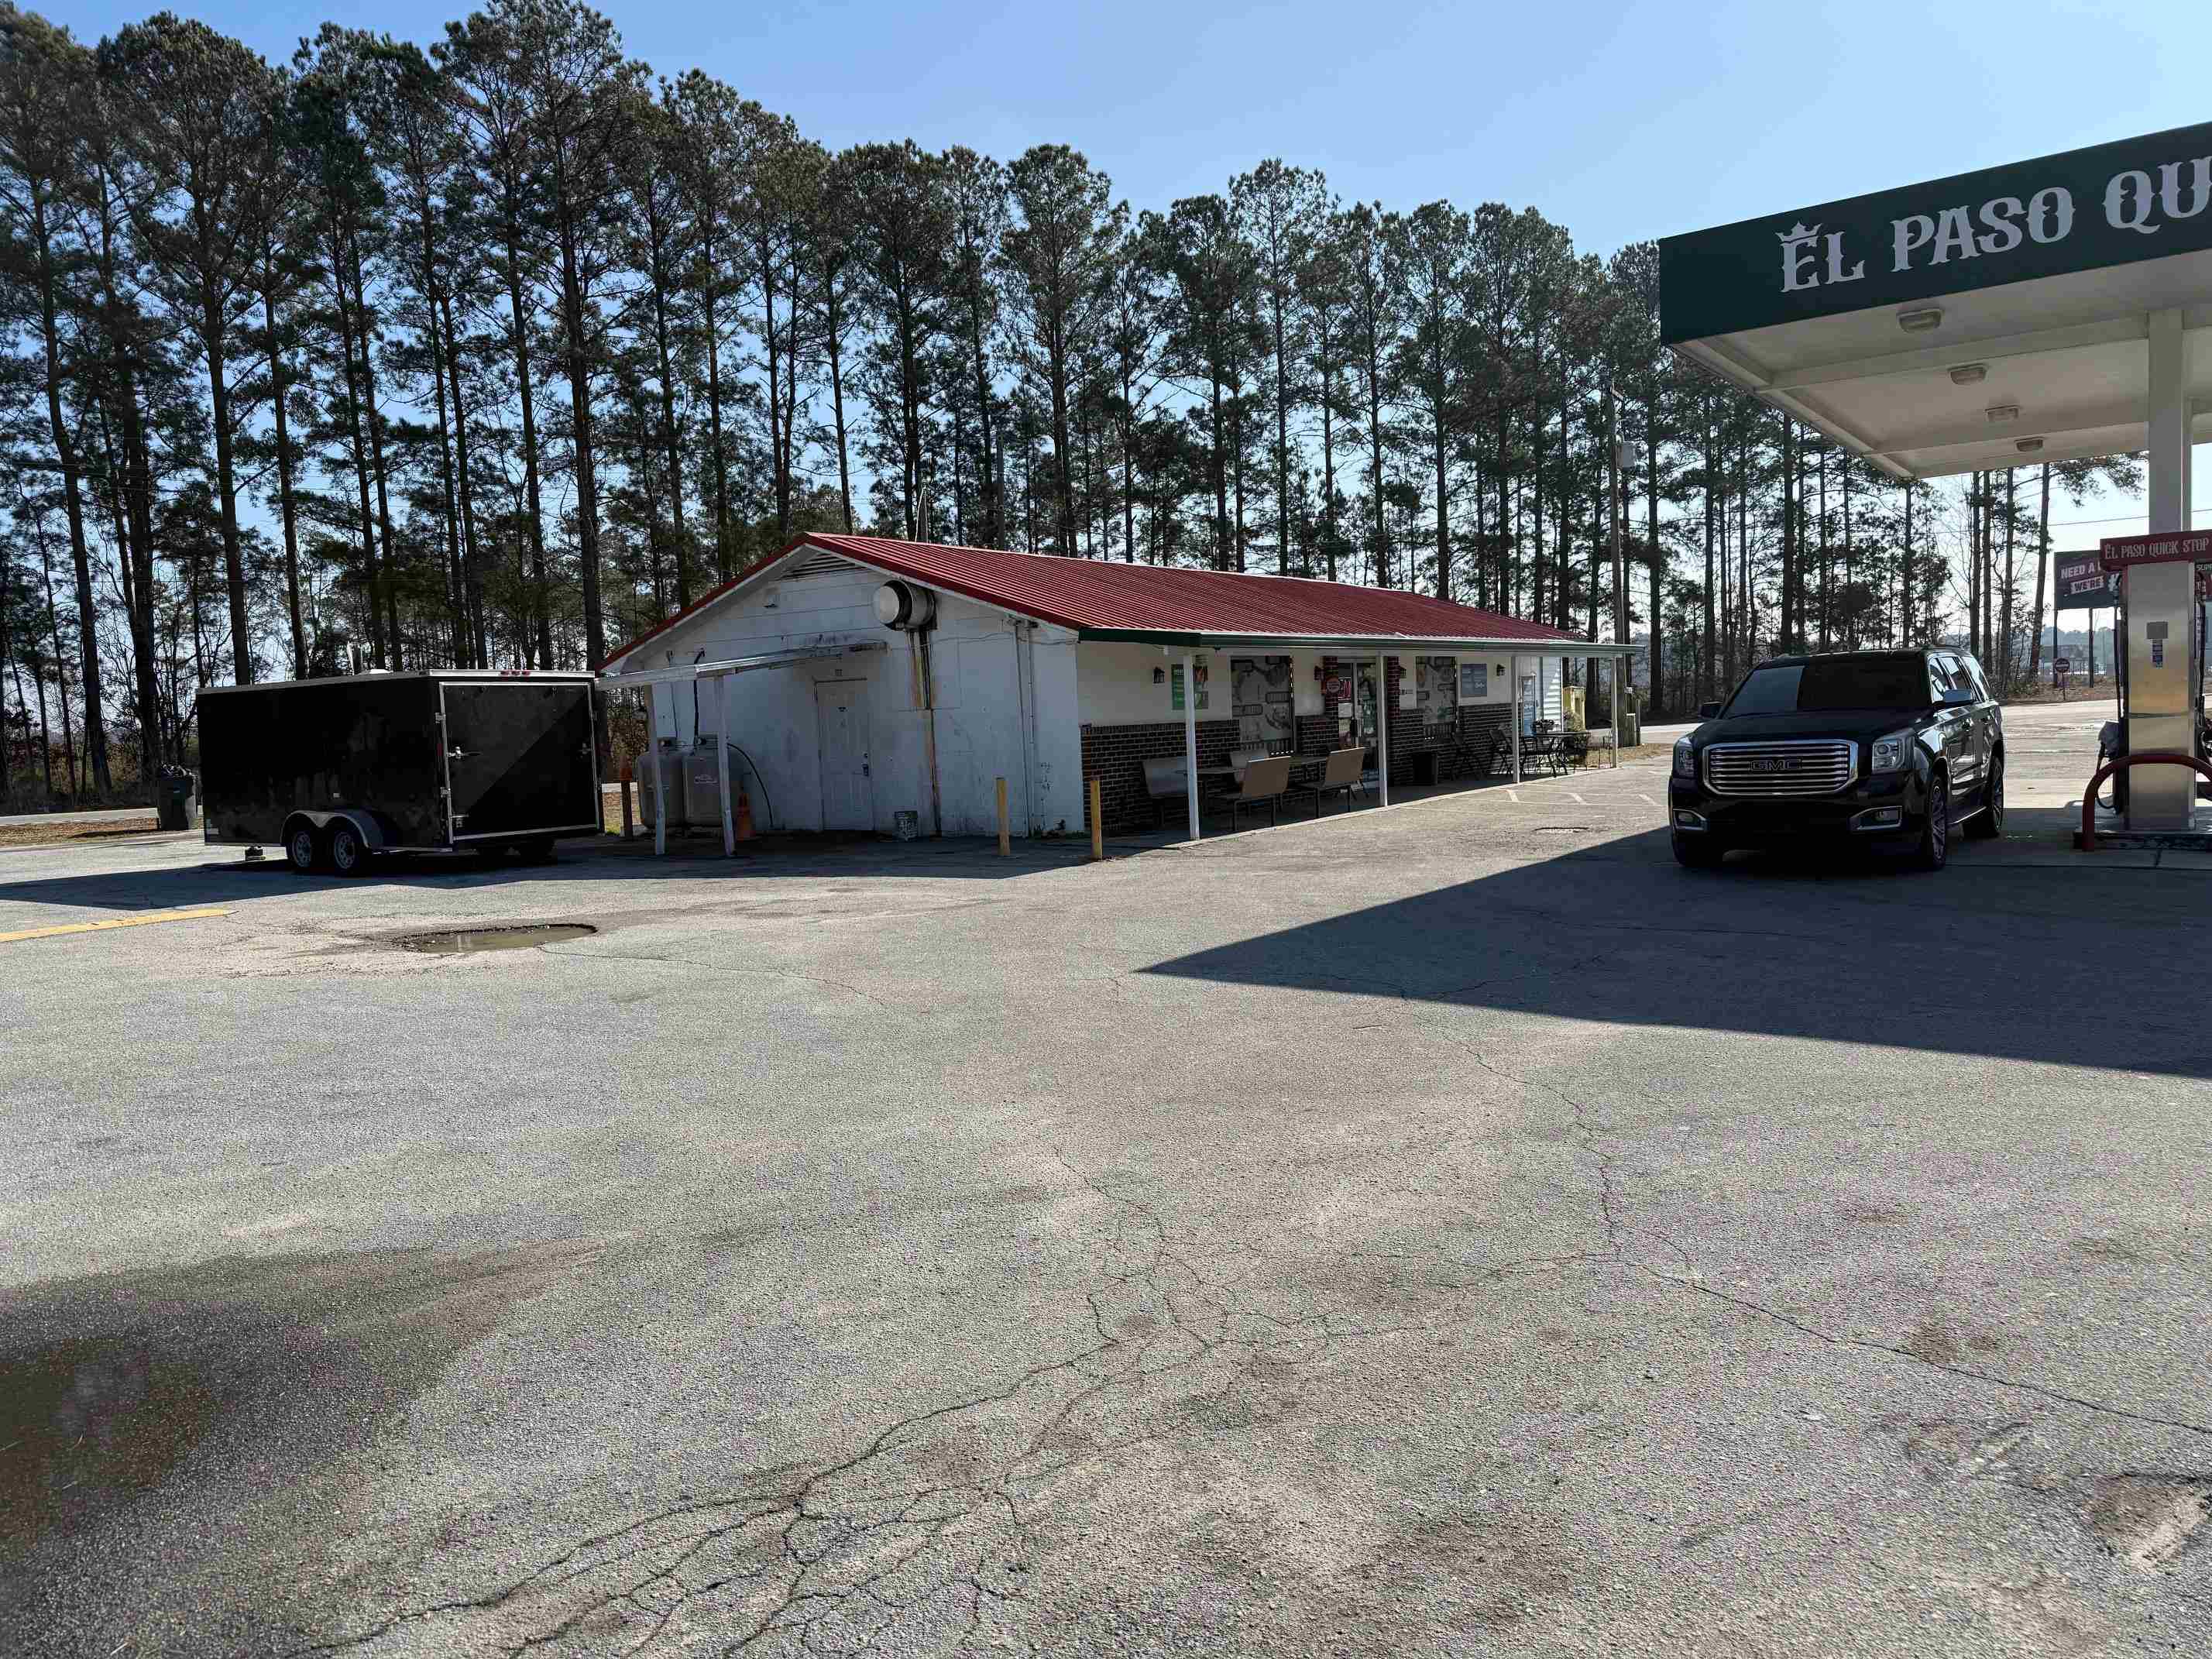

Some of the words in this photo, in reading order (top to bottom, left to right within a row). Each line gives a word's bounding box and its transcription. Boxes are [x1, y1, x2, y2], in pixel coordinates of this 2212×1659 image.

[1778, 226, 1865, 293] EL
[1890, 186, 2076, 273] PASO
[2104, 544, 2118, 559] EL
[2121, 543, 2146, 558] PASO
[2148, 540, 2179, 557] QUICK
[2183, 538, 2210, 552] STOP
[2060, 565, 2086, 579] NEED
[2087, 562, 2095, 574] A
[1747, 758, 1804, 773] GMC
